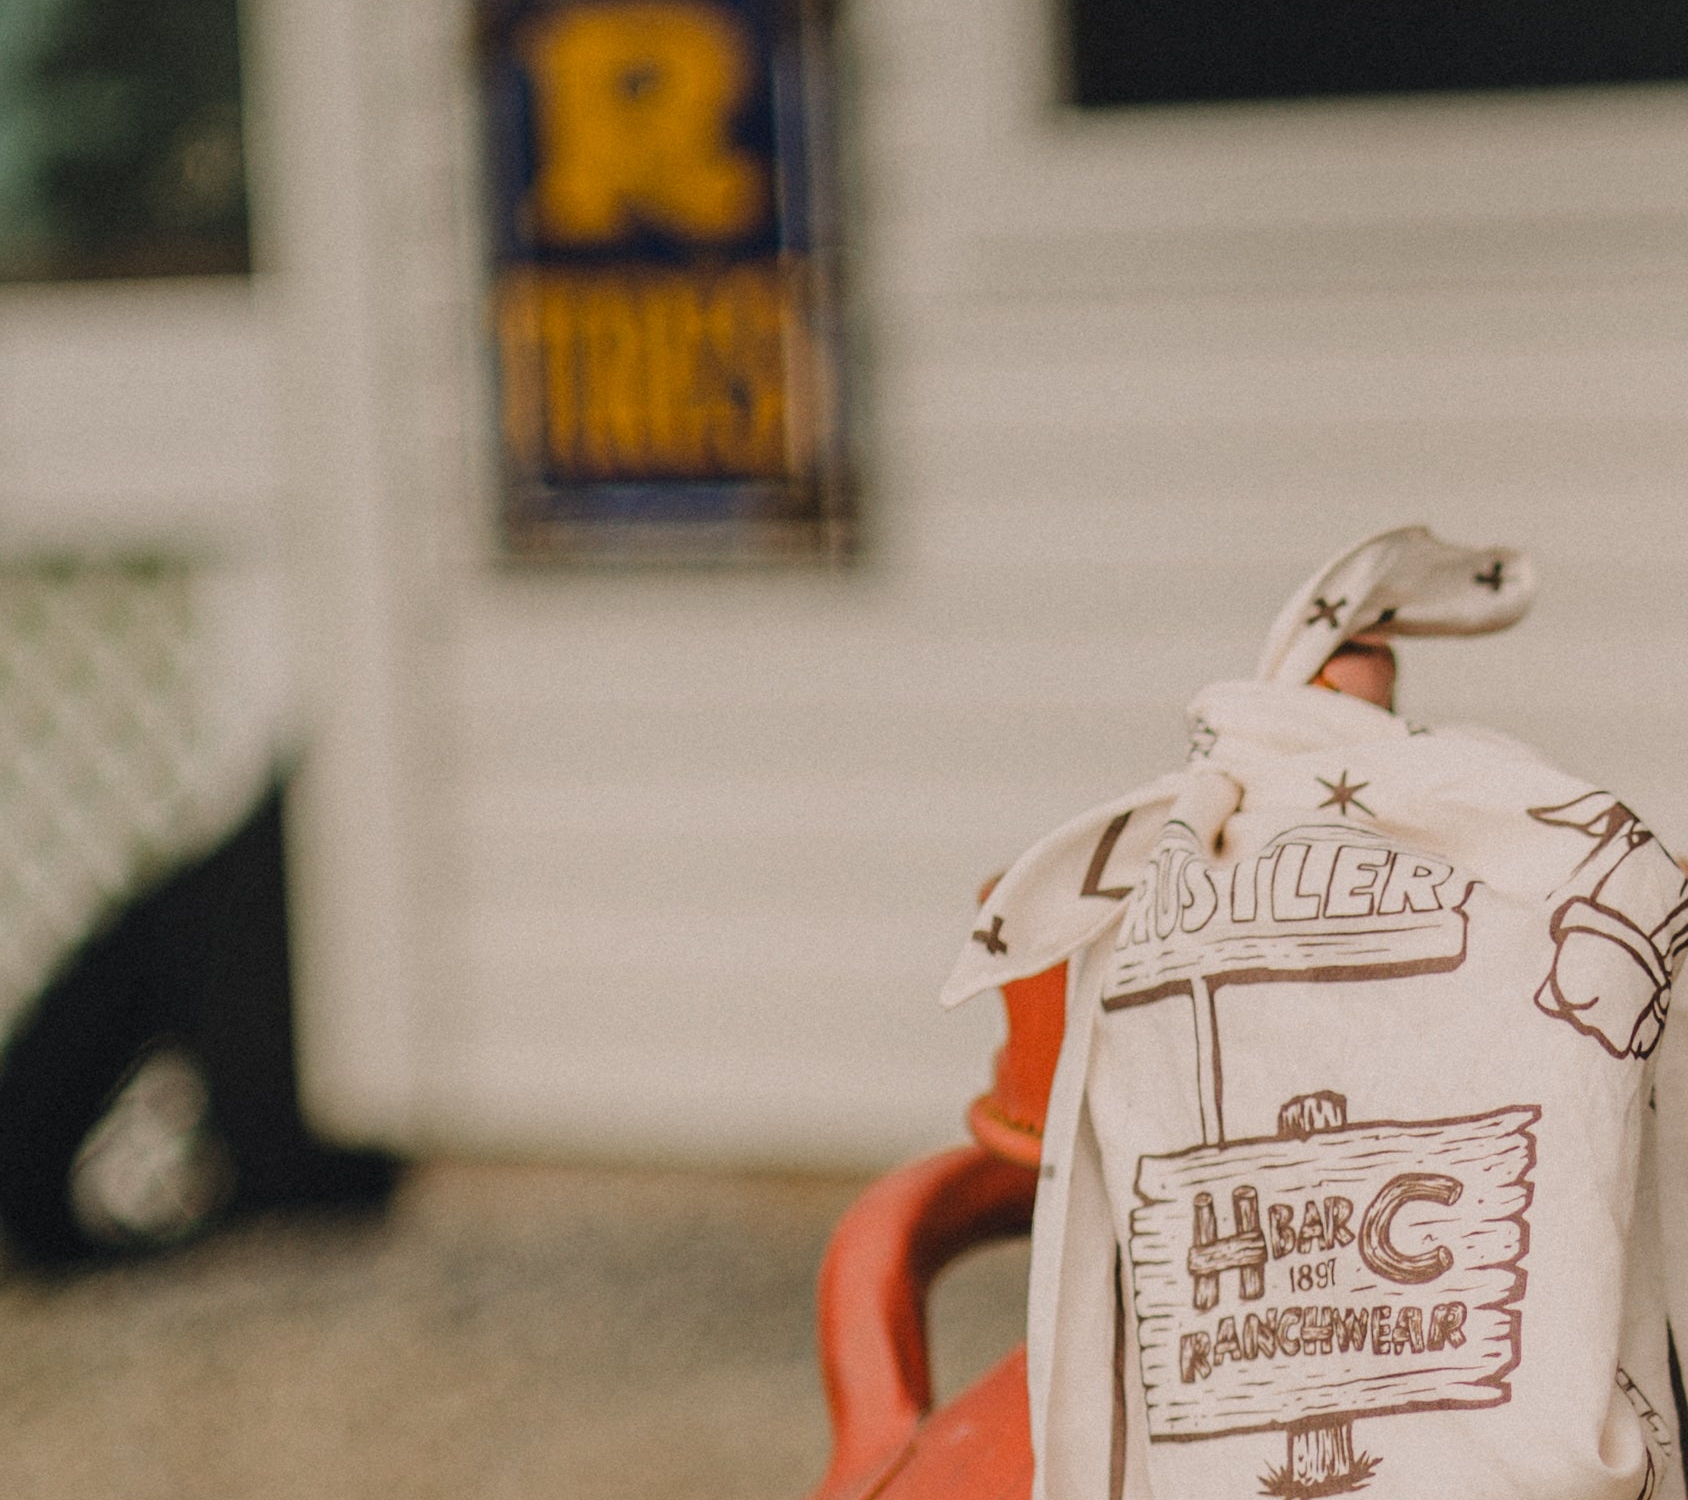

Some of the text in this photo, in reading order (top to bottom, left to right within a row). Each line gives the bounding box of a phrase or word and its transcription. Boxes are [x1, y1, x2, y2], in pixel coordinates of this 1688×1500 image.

[1186, 1171, 1465, 1313] H BAR C
[1288, 1256, 1338, 1294] 1897
[1178, 1300, 1469, 1384] RANCHWEAR
